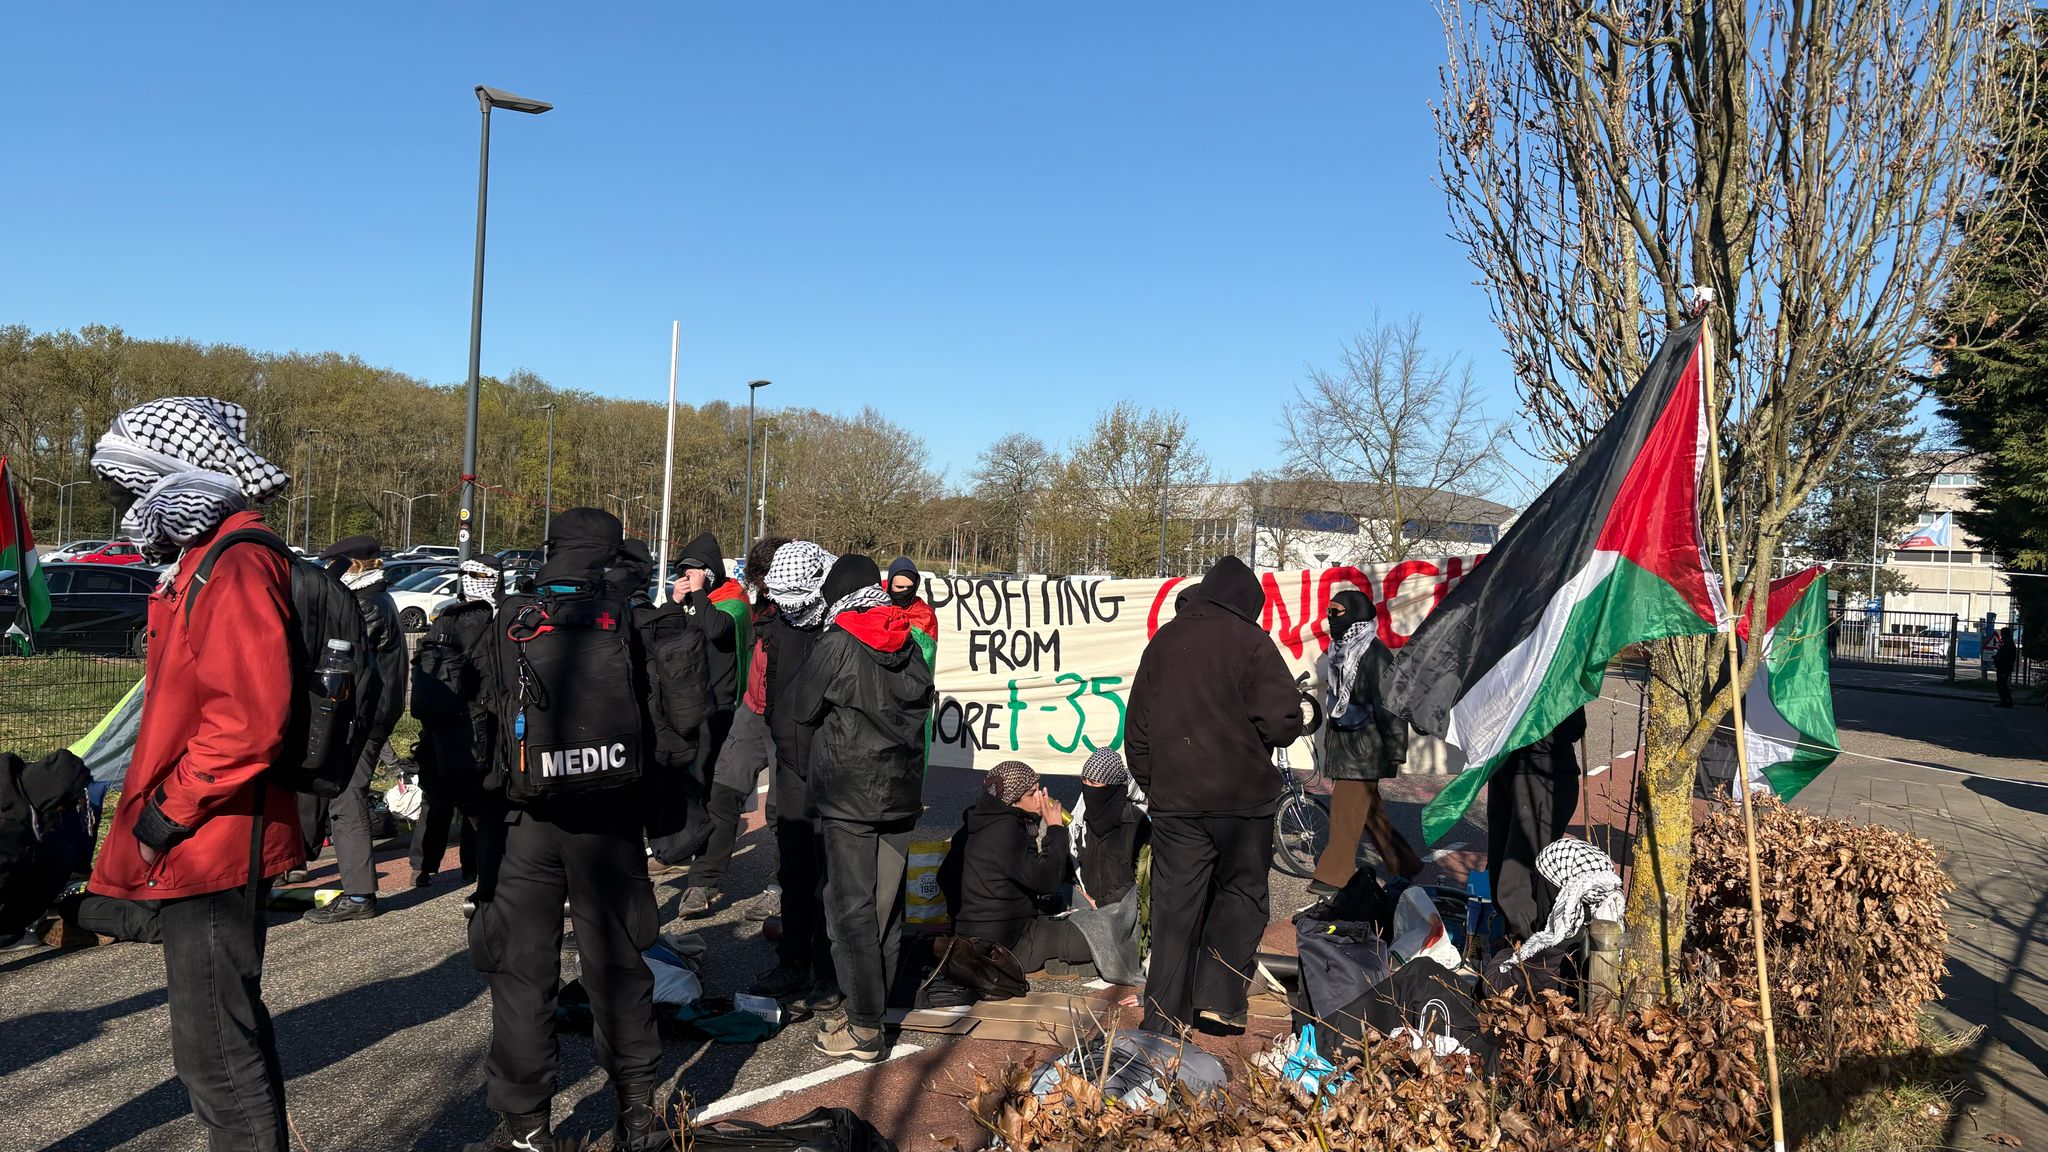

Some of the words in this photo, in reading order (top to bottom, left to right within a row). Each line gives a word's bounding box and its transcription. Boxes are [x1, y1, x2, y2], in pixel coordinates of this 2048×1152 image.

[968, 628, 1061, 674] FROM
[541, 742, 626, 778] MEDIC
[920, 884, 938, 894] 1921
